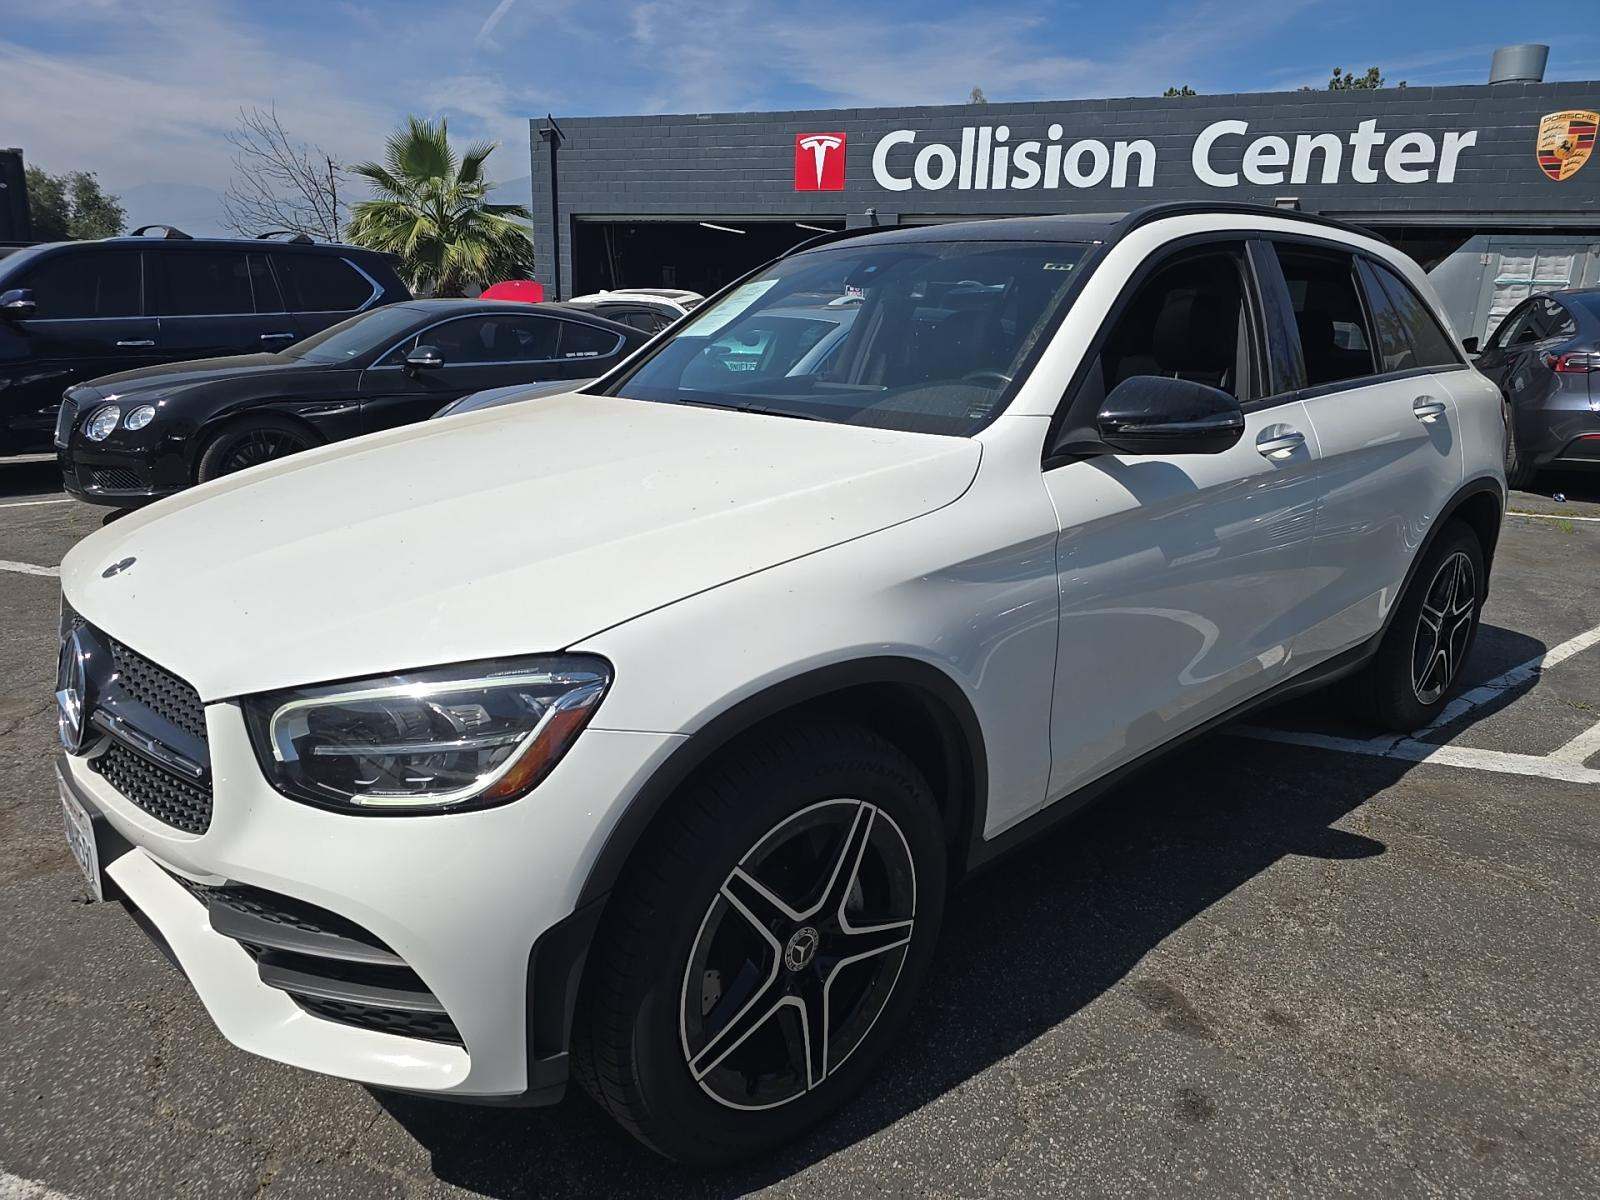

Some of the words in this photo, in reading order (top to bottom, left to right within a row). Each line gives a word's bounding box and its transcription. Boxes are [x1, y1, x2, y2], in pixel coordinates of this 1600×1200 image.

[1544, 113, 1597, 123] PORSCHE
[872, 124, 1157, 192] Collision
[1191, 118, 1478, 188] Center
